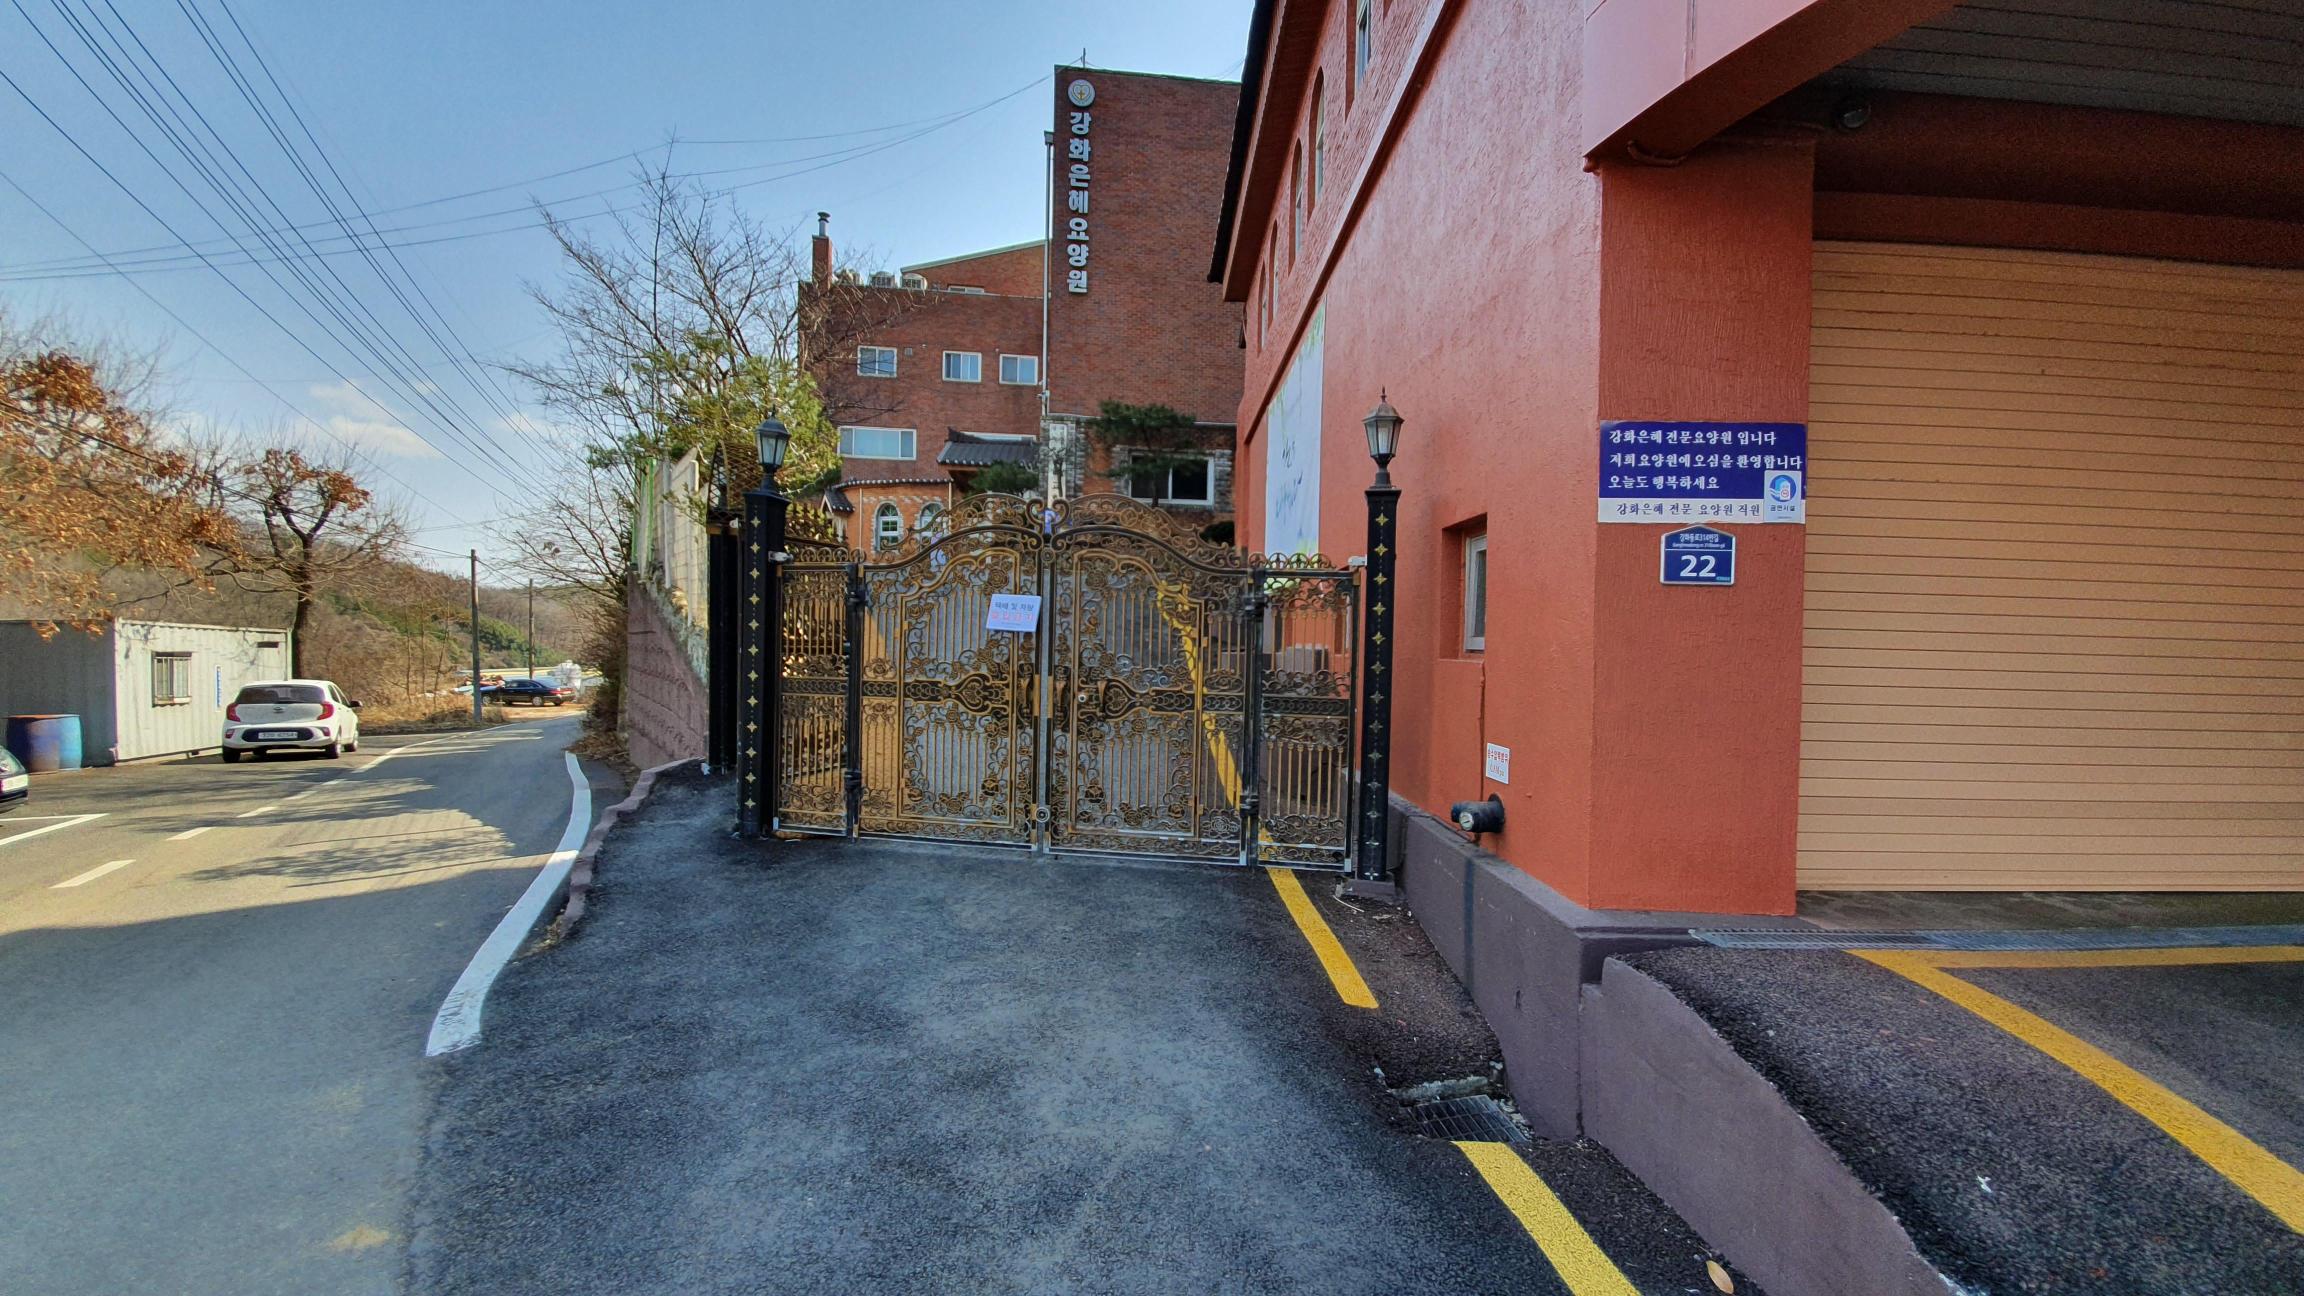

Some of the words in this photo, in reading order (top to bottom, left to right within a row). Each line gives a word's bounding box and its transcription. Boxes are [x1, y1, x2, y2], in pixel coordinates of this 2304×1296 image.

[1067, 112, 1092, 293] 강화은혜요양원
[1609, 430, 1662, 444] 강화은혜
[1666, 430, 1732, 445] 전문요양원
[1737, 431, 1777, 446] 입니다
[1736, 455, 1803, 470] 환영합니다
[1608, 475, 1649, 489] 오늘도
[1652, 475, 1720, 490] 행복하세요
[1616, 503, 1664, 515] 강화은혜
[1669, 503, 1692, 515] 전문
[1698, 504, 1733, 516] 요양원
[1737, 504, 1760, 516] 직원
[1680, 554, 1716, 577] 22
